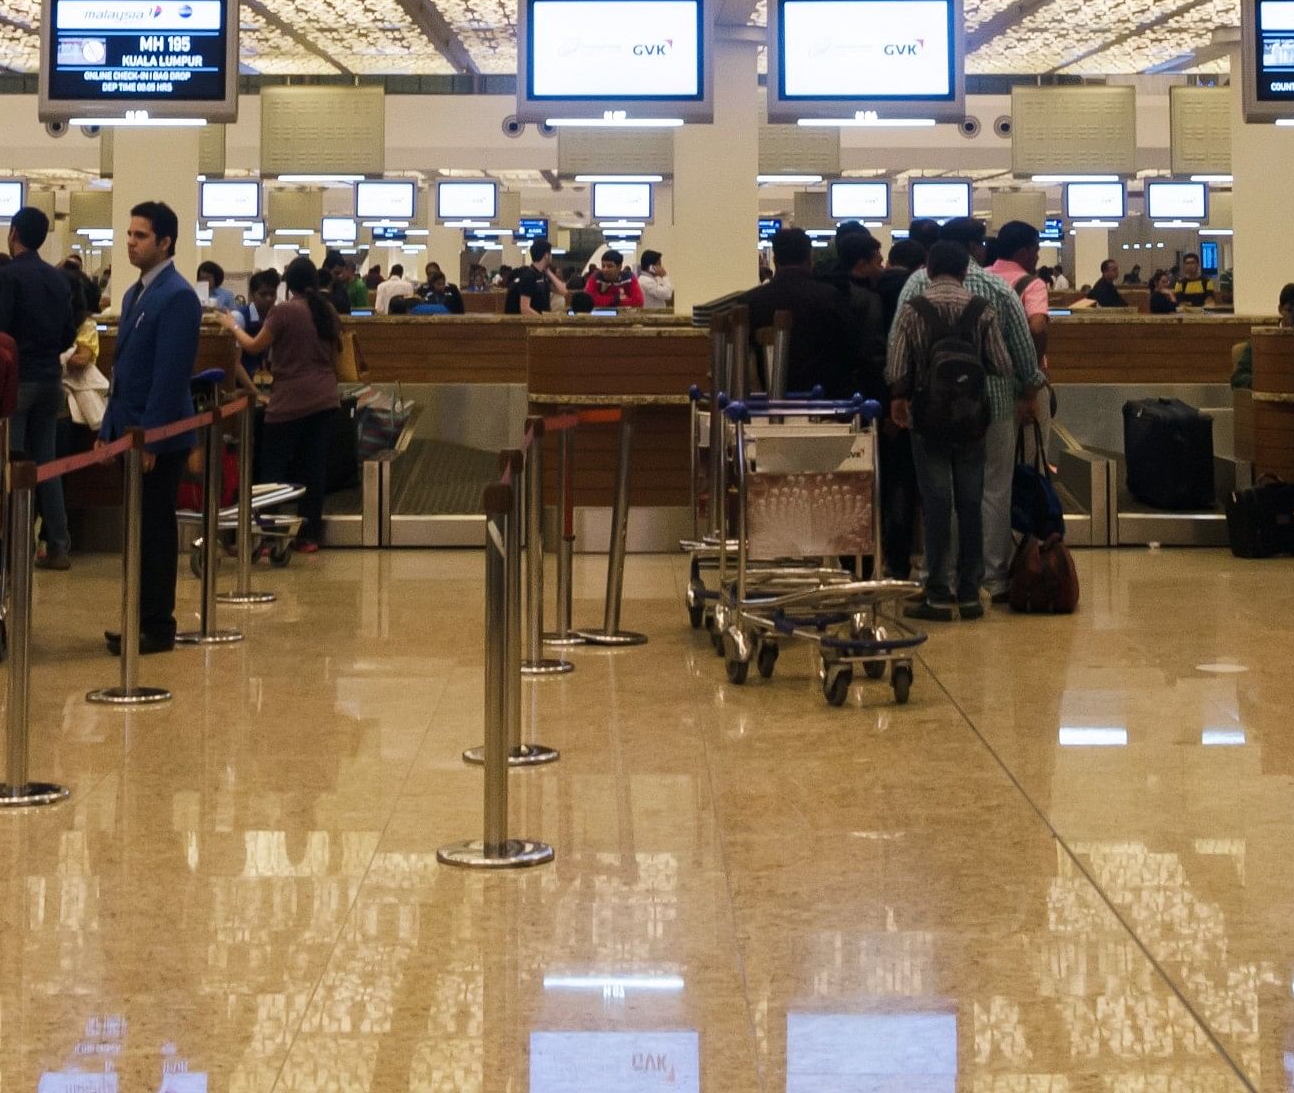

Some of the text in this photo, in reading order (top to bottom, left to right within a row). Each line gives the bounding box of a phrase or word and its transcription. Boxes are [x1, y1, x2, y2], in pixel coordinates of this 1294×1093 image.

[84, 8, 144, 21] malaysia
[139, 36, 191, 52] MH 195
[632, 44, 666, 56] GVK
[883, 44, 918, 56] GVK
[122, 55, 203, 67] KUALA LUMPUR
[84, 71, 113, 81] ONLINE
[113, 71, 149, 81] CHECK-IN
[169, 71, 191, 81] DROP
[102, 82, 117, 92] DEP
[118, 82, 136, 92] TIME
